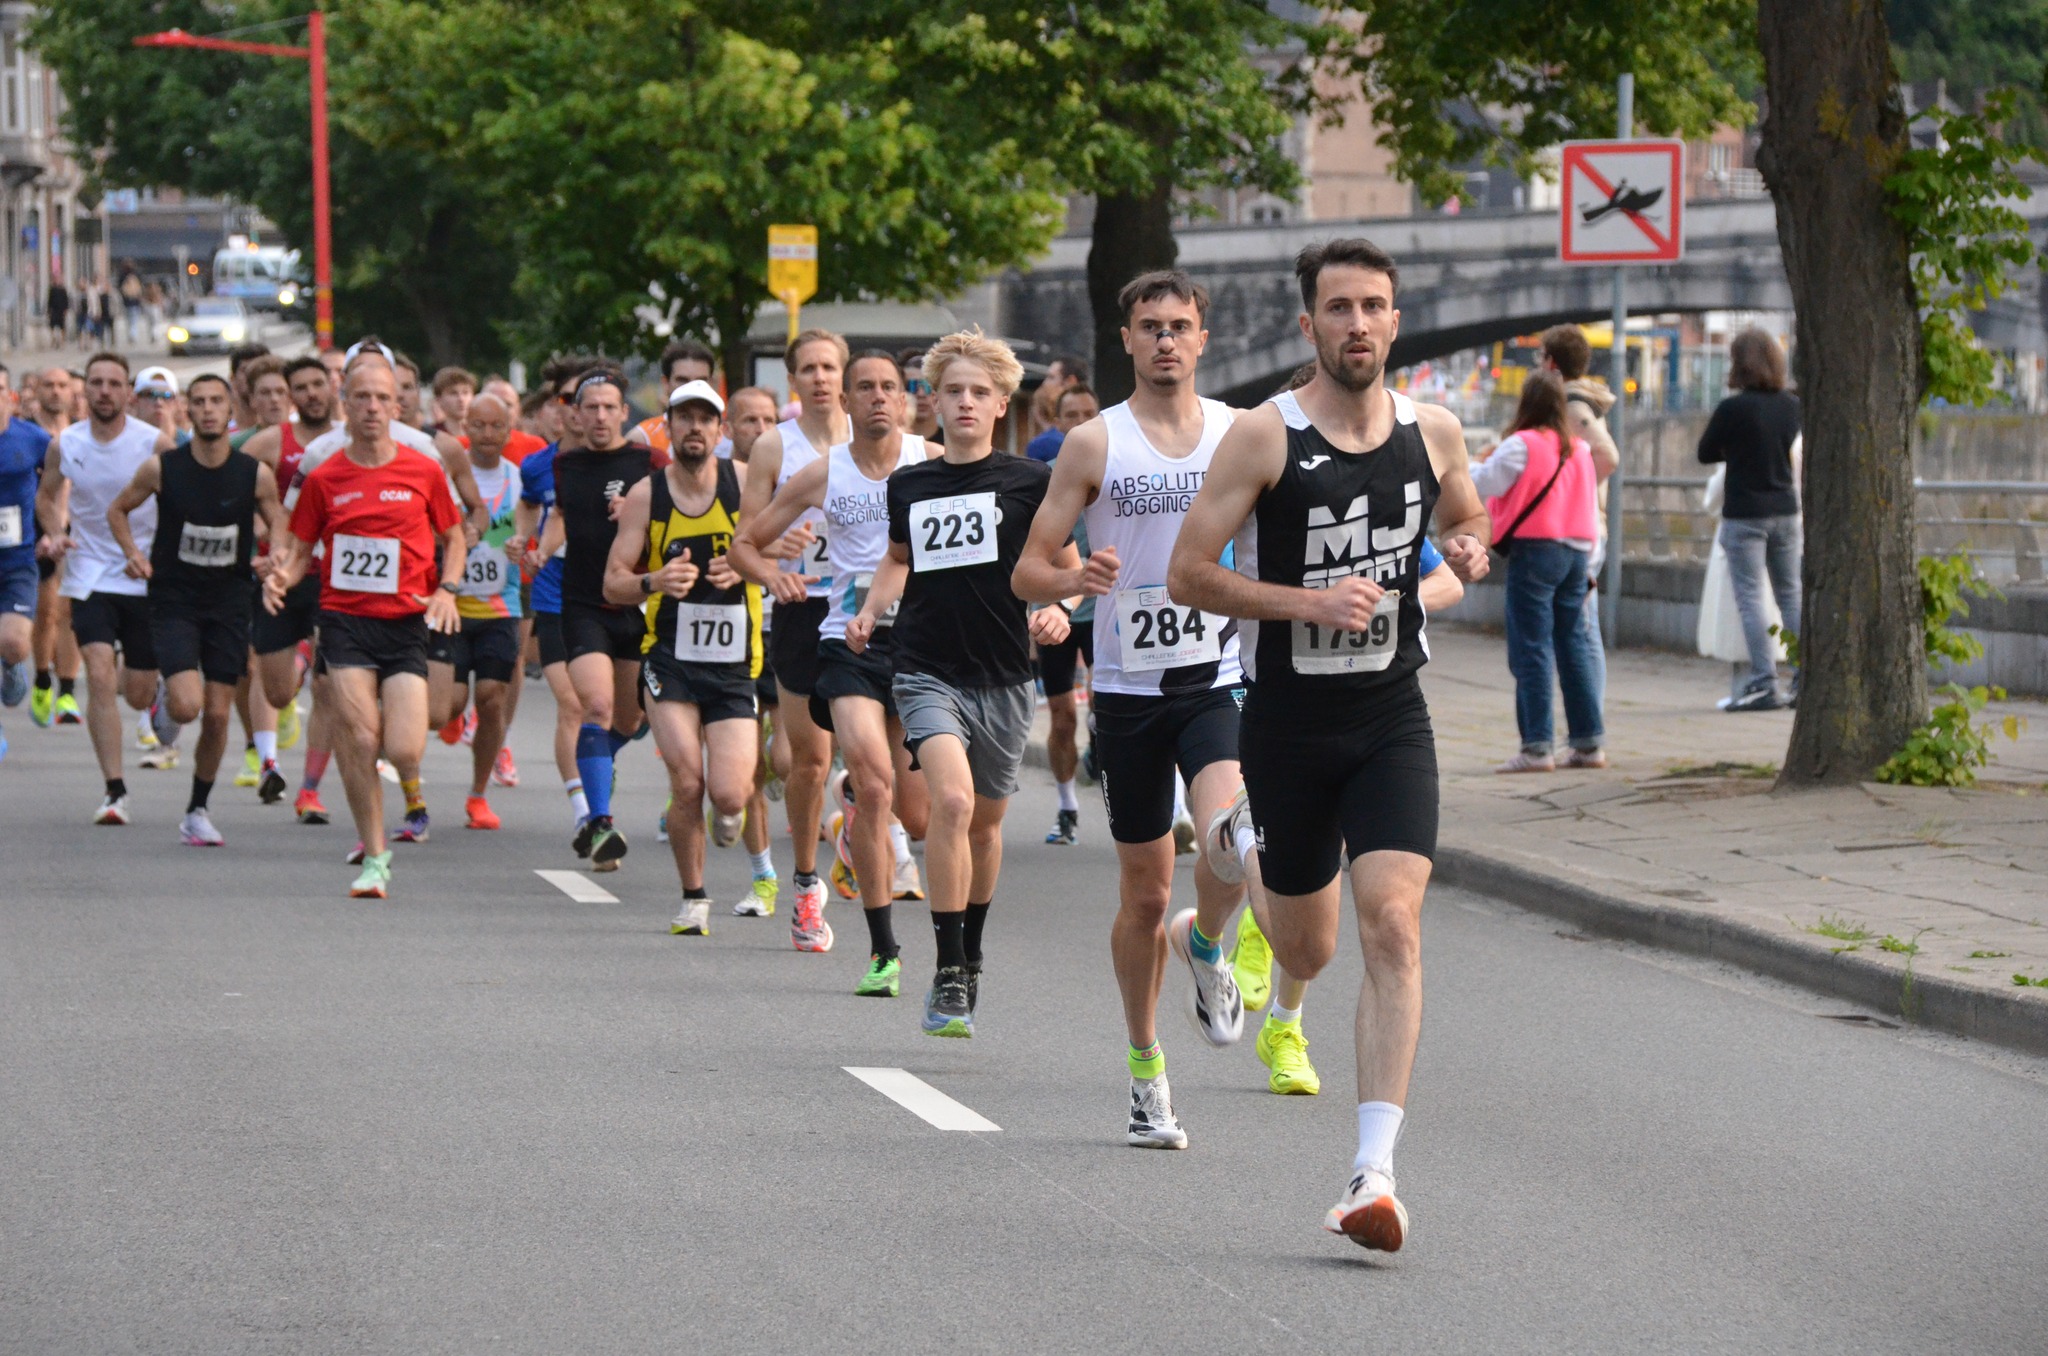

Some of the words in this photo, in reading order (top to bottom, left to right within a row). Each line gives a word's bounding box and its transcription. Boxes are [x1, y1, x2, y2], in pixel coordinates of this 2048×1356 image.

[830, 491, 886, 512] ABSOLU
[922, 511, 985, 551] 223
[1304, 480, 1422, 566] MJ
[341, 550, 389, 578] 222
[689, 620, 734, 647] 170
[1131, 607, 1206, 649] 284
[1304, 614, 1390, 649] 1759
